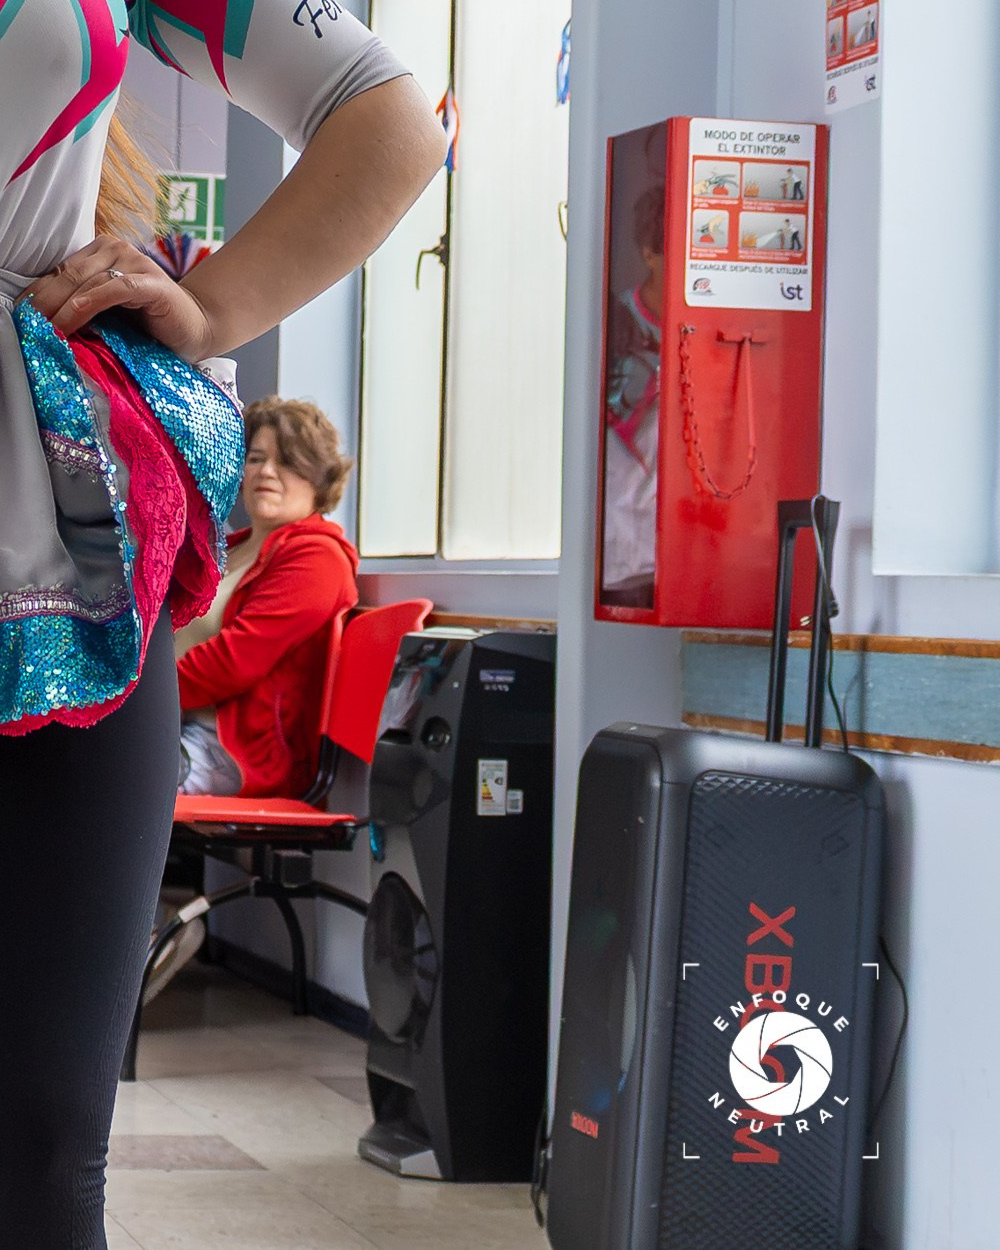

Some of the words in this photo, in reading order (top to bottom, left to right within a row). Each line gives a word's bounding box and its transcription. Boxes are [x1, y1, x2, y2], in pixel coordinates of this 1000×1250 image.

[704, 130, 737, 140] MODO
[740, 131, 754, 141] DE
[757, 132, 801, 143] OPERAR
[718, 143, 729, 153] EL
[733, 144, 786, 156] EXTINTOR
[779, 282, 803, 301] ist
